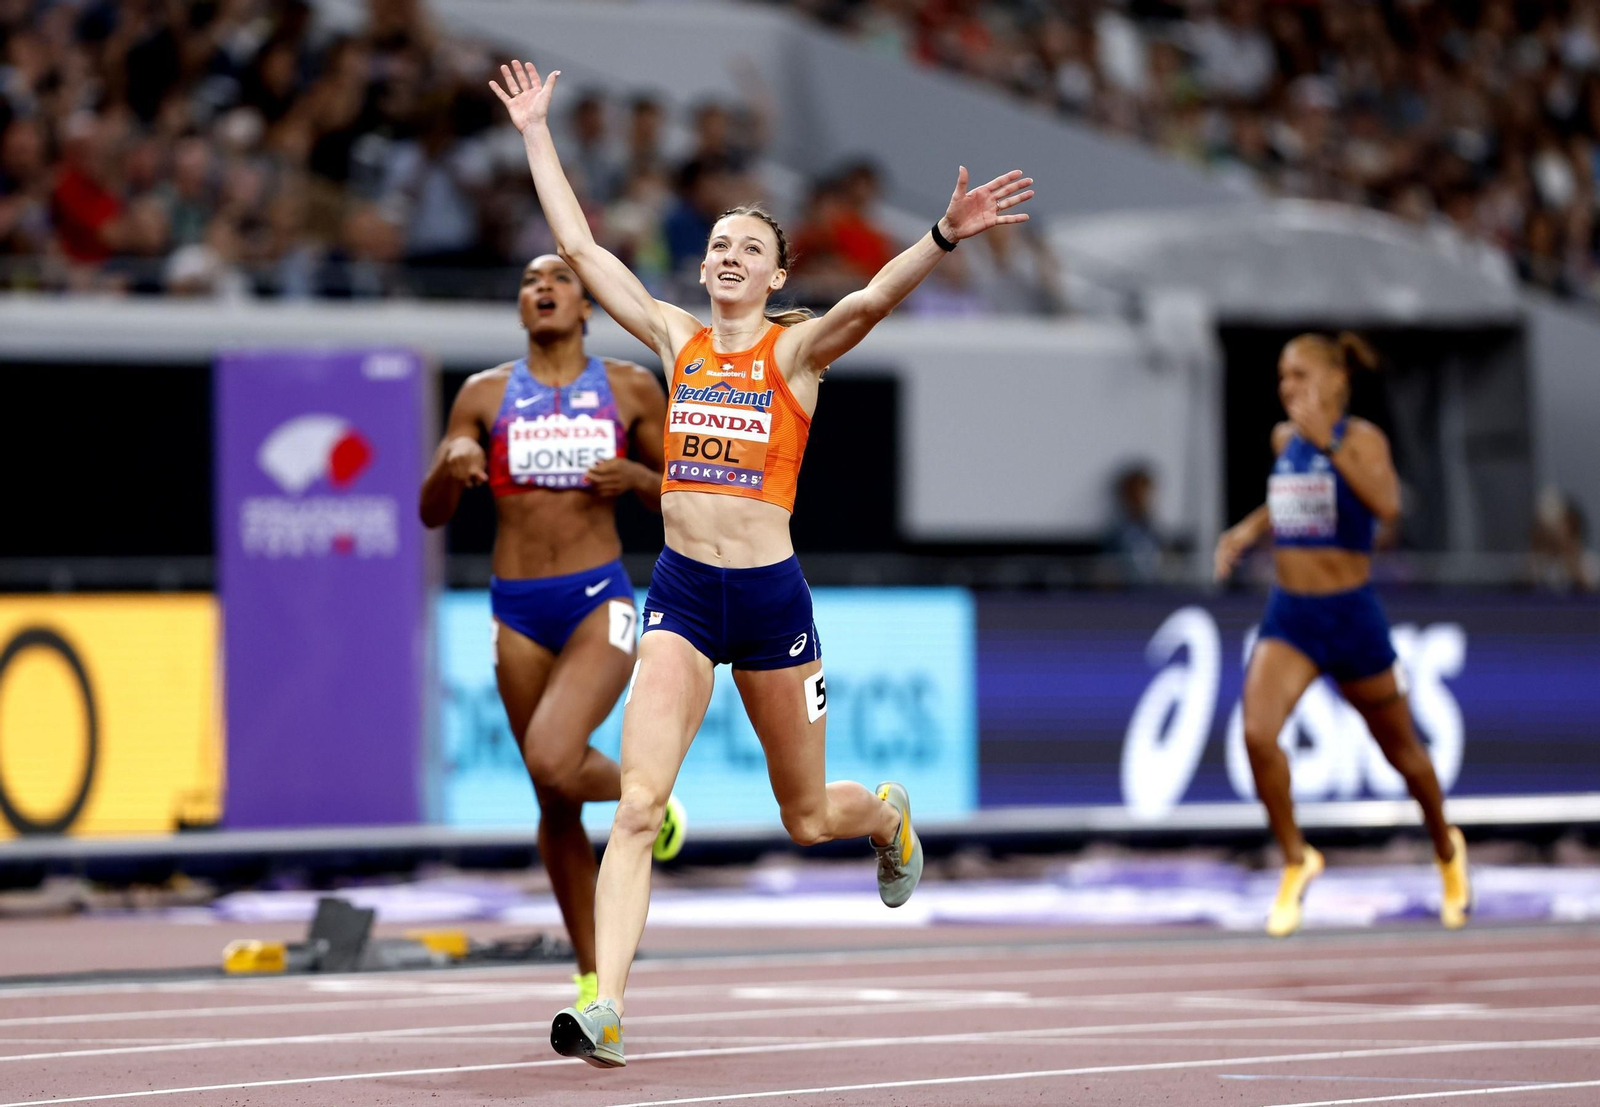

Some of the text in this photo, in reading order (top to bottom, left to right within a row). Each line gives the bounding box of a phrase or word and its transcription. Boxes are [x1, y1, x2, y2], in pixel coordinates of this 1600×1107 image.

[513, 427, 608, 441] HONDA
[671, 411, 767, 434] HONDA
[517, 447, 606, 470] JONES
[682, 434, 739, 463] BOL
[622, 613, 633, 641] 7
[815, 675, 827, 711] 5
